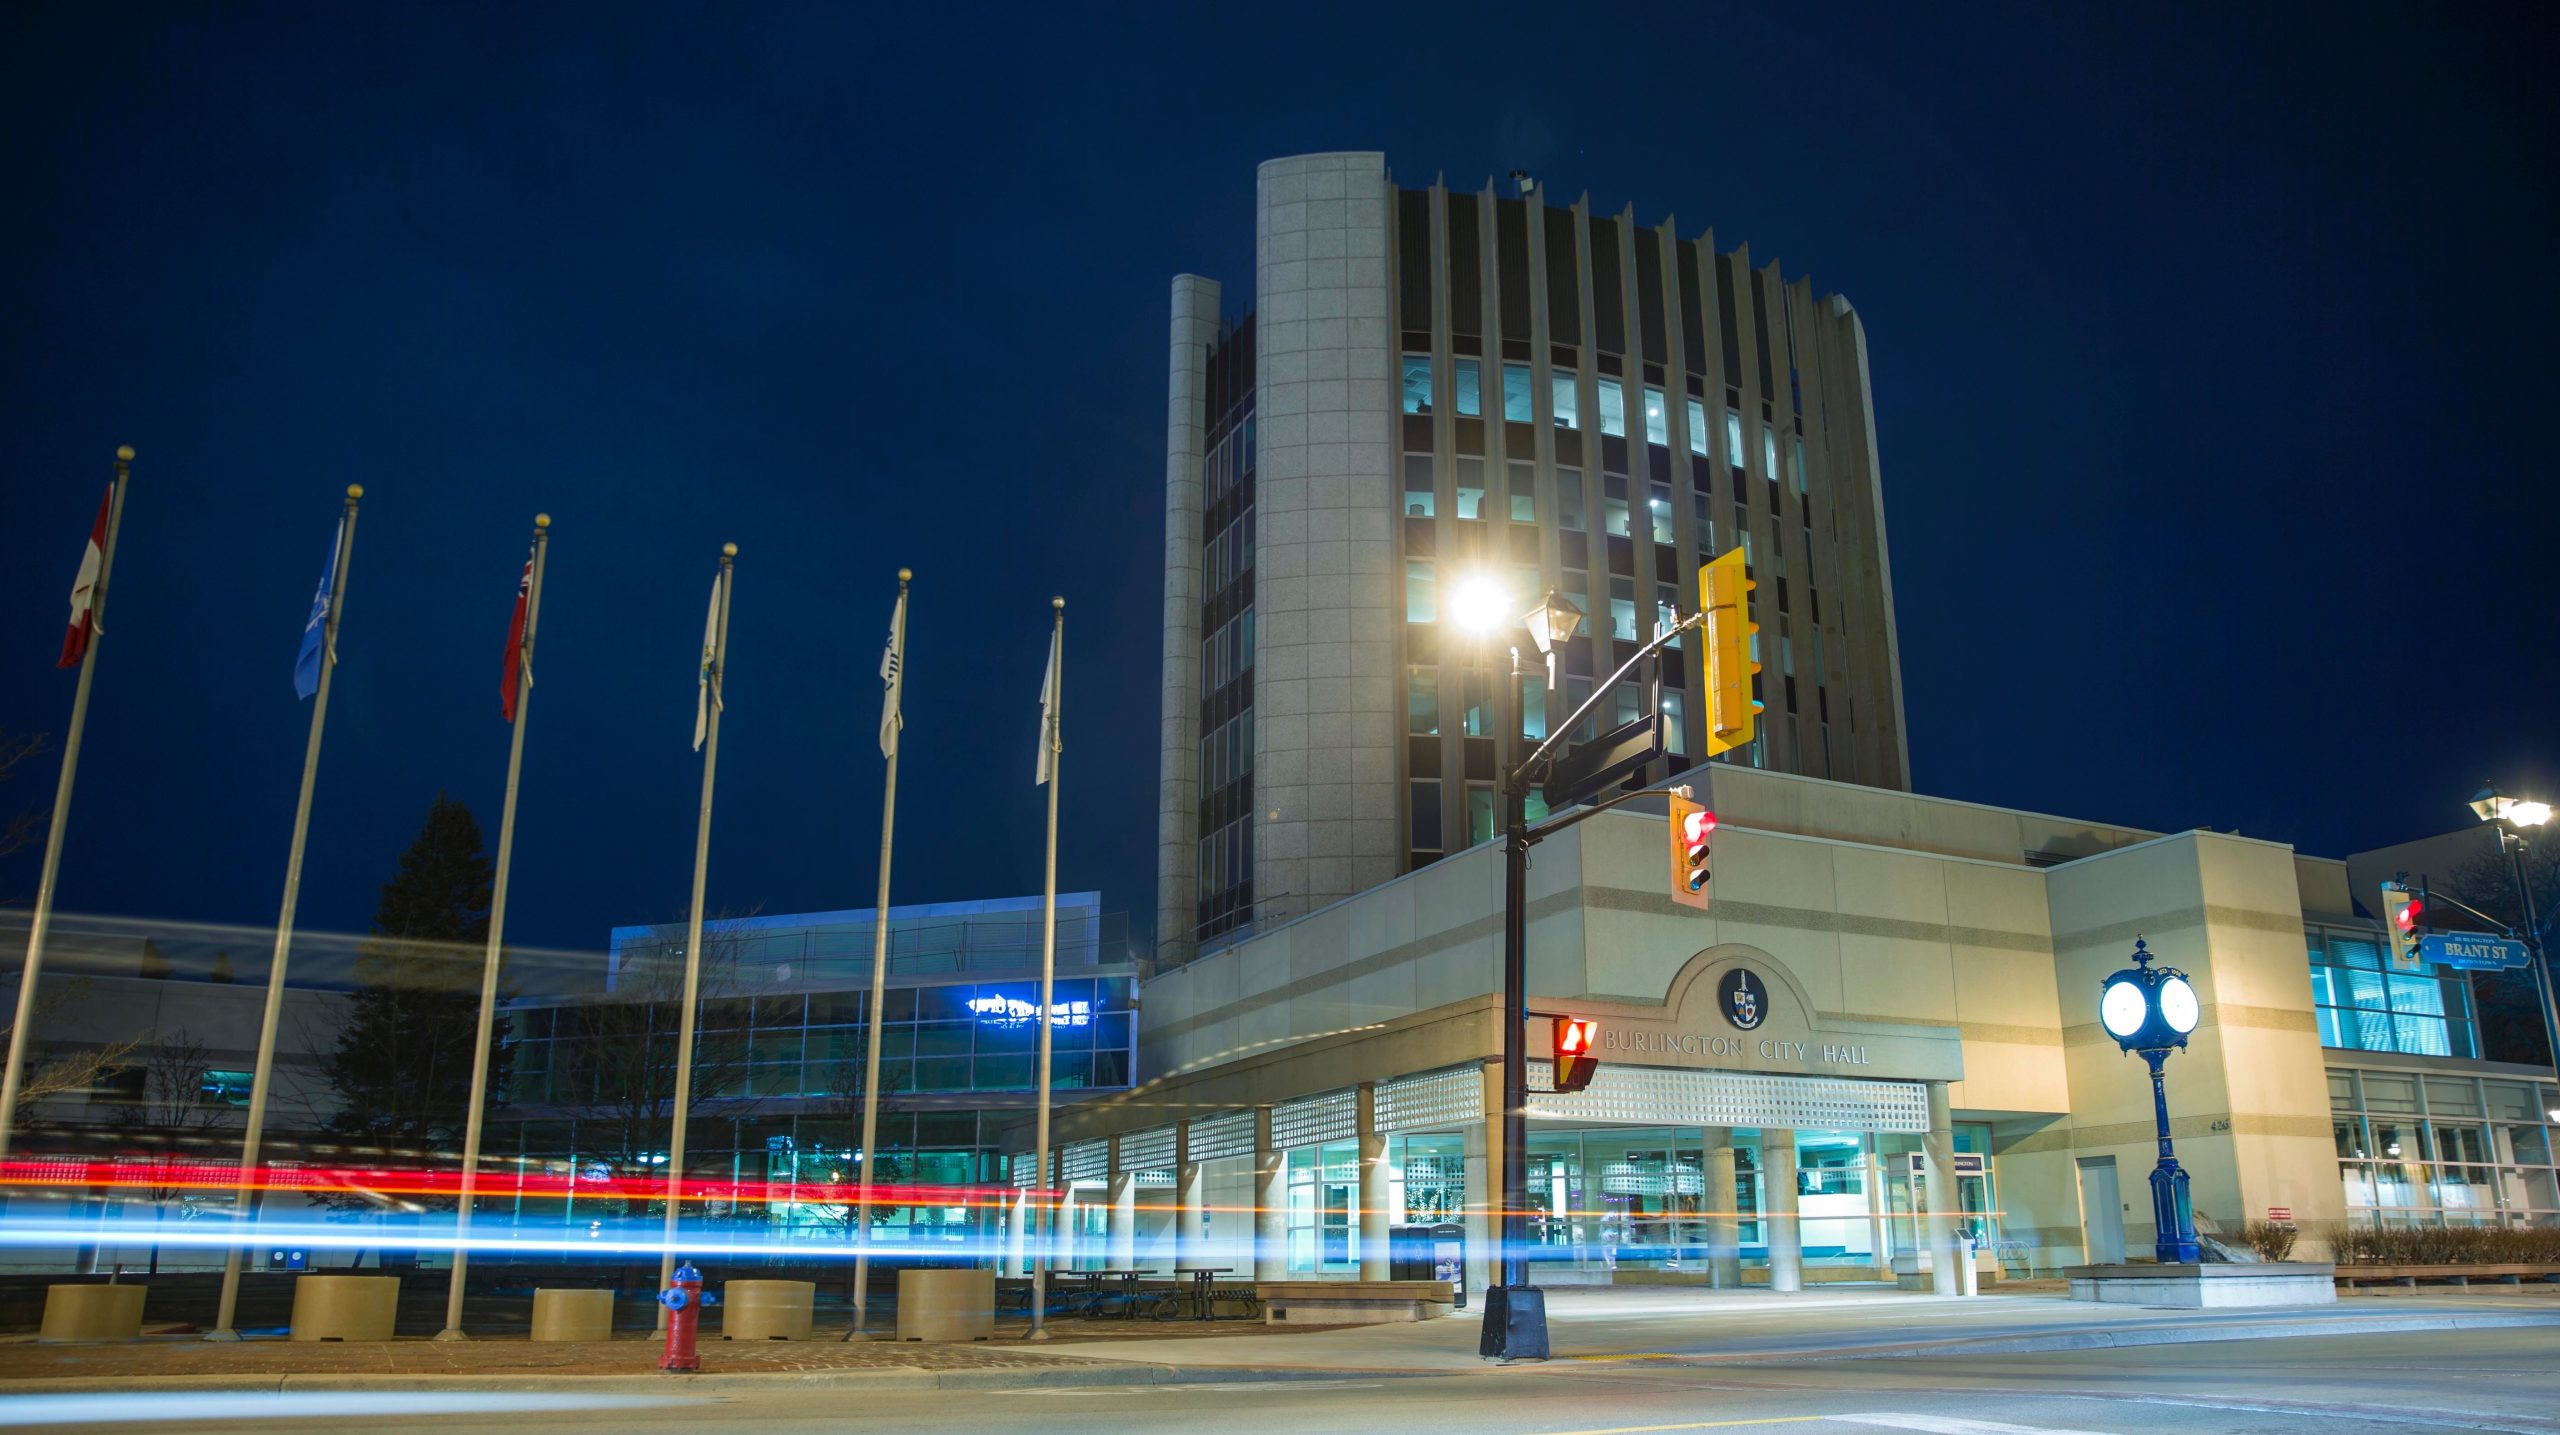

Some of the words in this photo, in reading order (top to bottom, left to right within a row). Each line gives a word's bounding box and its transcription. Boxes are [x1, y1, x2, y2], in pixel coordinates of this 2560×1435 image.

[2454, 936, 2495, 944] BURLINGTON
[2444, 943, 2490, 958] BRANT
[2492, 946, 2508, 960] ST
[1605, 1031, 1743, 1057] BURLINGTON
[1760, 1040, 1806, 1061] CITY
[1823, 1045, 1870, 1065] HALL
[2210, 1119, 2230, 1131] 426
